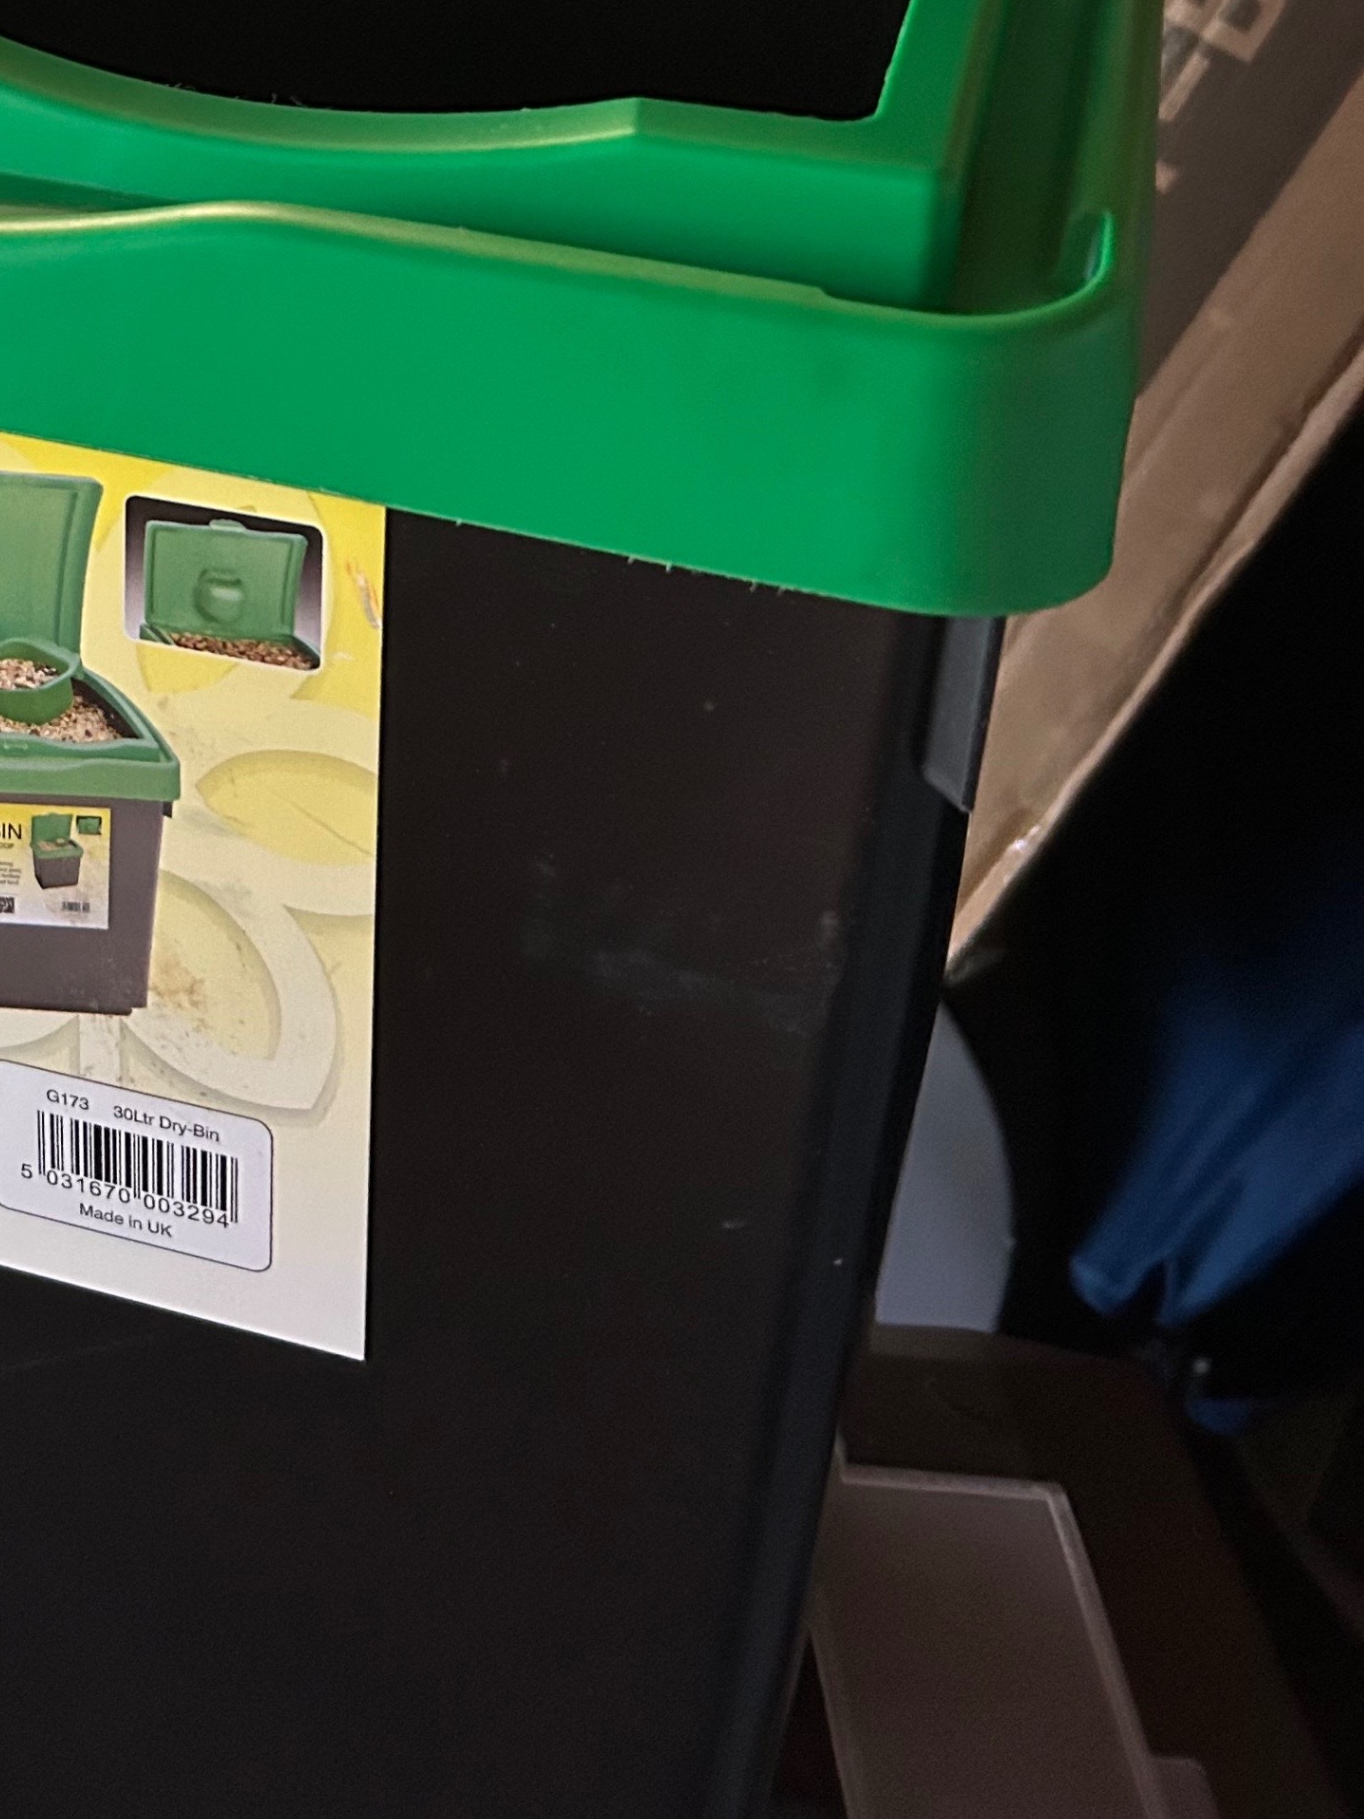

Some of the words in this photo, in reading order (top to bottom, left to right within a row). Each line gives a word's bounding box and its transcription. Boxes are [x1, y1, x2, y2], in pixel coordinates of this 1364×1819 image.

[46, 1088, 90, 1111] G173
[113, 1104, 155, 1127] 30Ltr
[159, 1115, 220, 1142] Dry-Bin
[20, 1162, 33, 1179] 5
[46, 1168, 131, 1205] 031670
[143, 1192, 230, 1229] 003294
[79, 1202, 125, 1226] Made
[128, 1216, 143, 1230] in
[147, 1220, 173, 1238] UK
